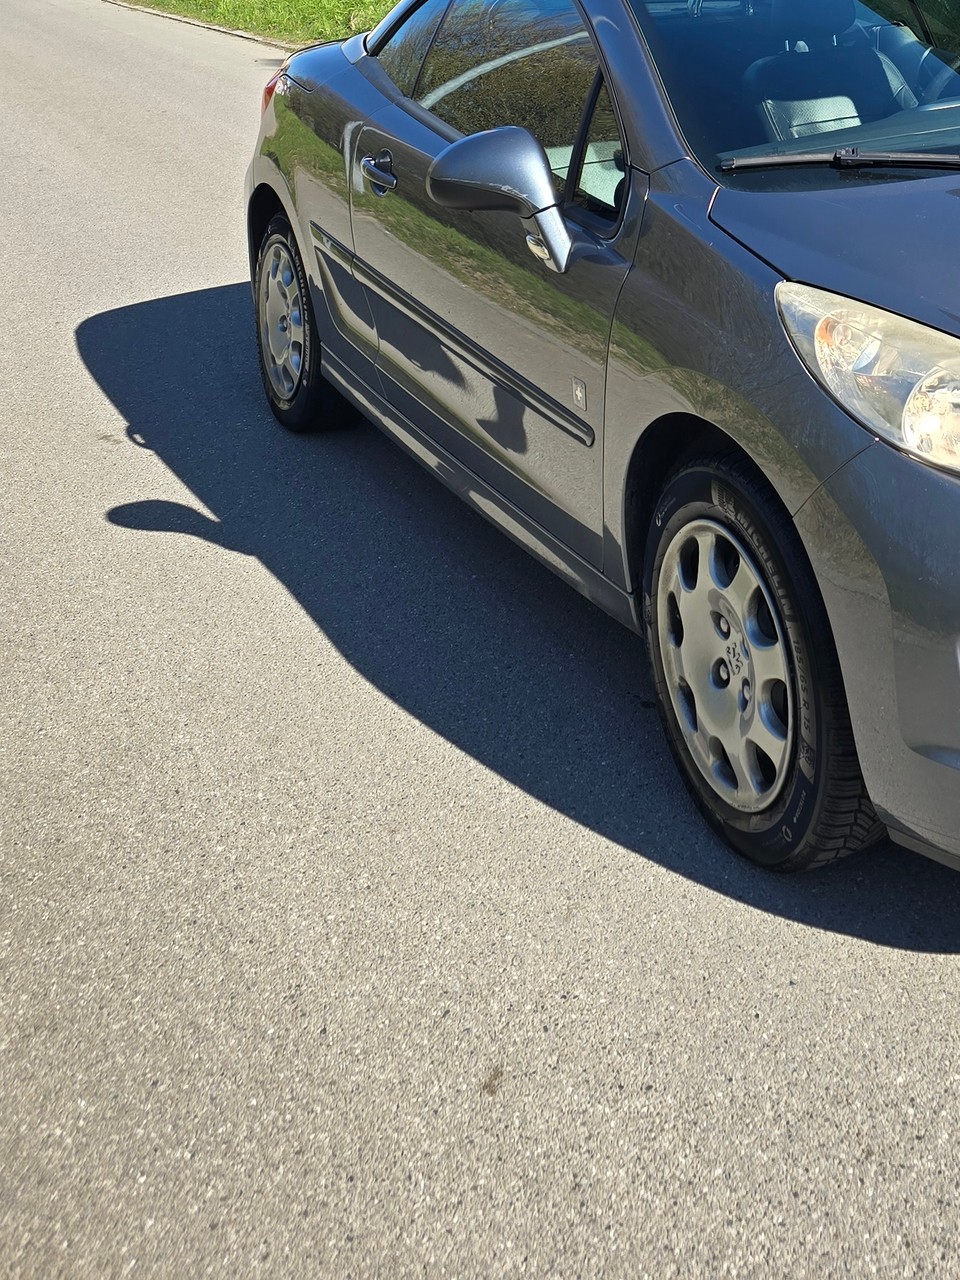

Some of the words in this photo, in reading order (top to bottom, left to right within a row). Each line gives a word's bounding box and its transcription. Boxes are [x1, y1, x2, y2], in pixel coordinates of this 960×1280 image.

[736, 510, 794, 617] MICHELIN
[793, 640, 808, 695] 185/65
[802, 697, 810, 711] R
[802, 716, 811, 734] 15
